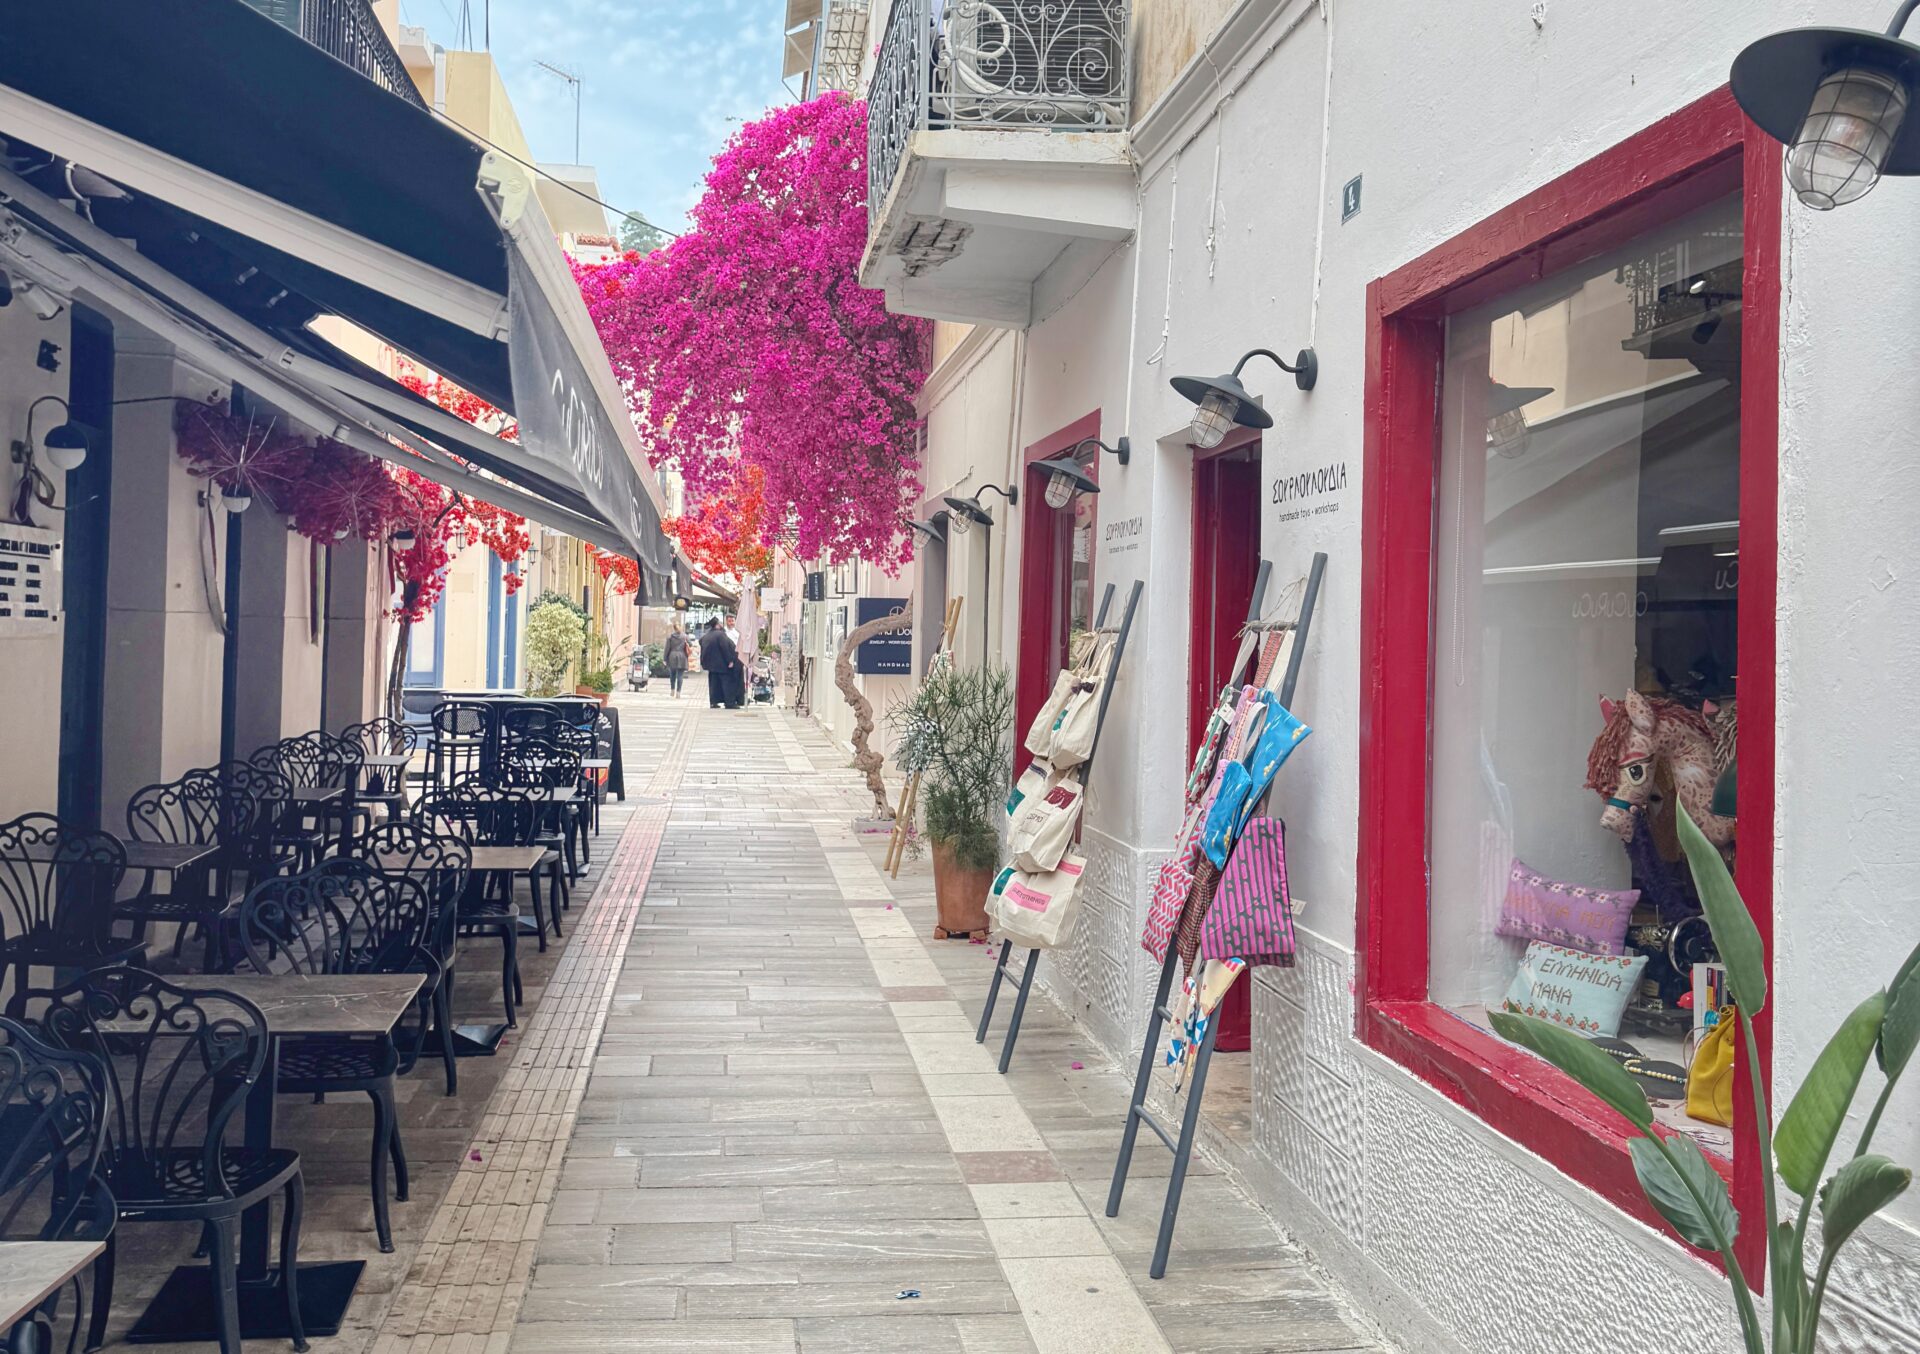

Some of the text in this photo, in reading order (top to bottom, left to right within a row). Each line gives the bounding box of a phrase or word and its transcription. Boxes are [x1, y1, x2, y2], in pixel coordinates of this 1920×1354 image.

[1349, 185, 1356, 211] 4
[1279, 500, 1339, 522] handmade toys workshops
[1531, 981, 1573, 1005] ΜΑΝΑ
